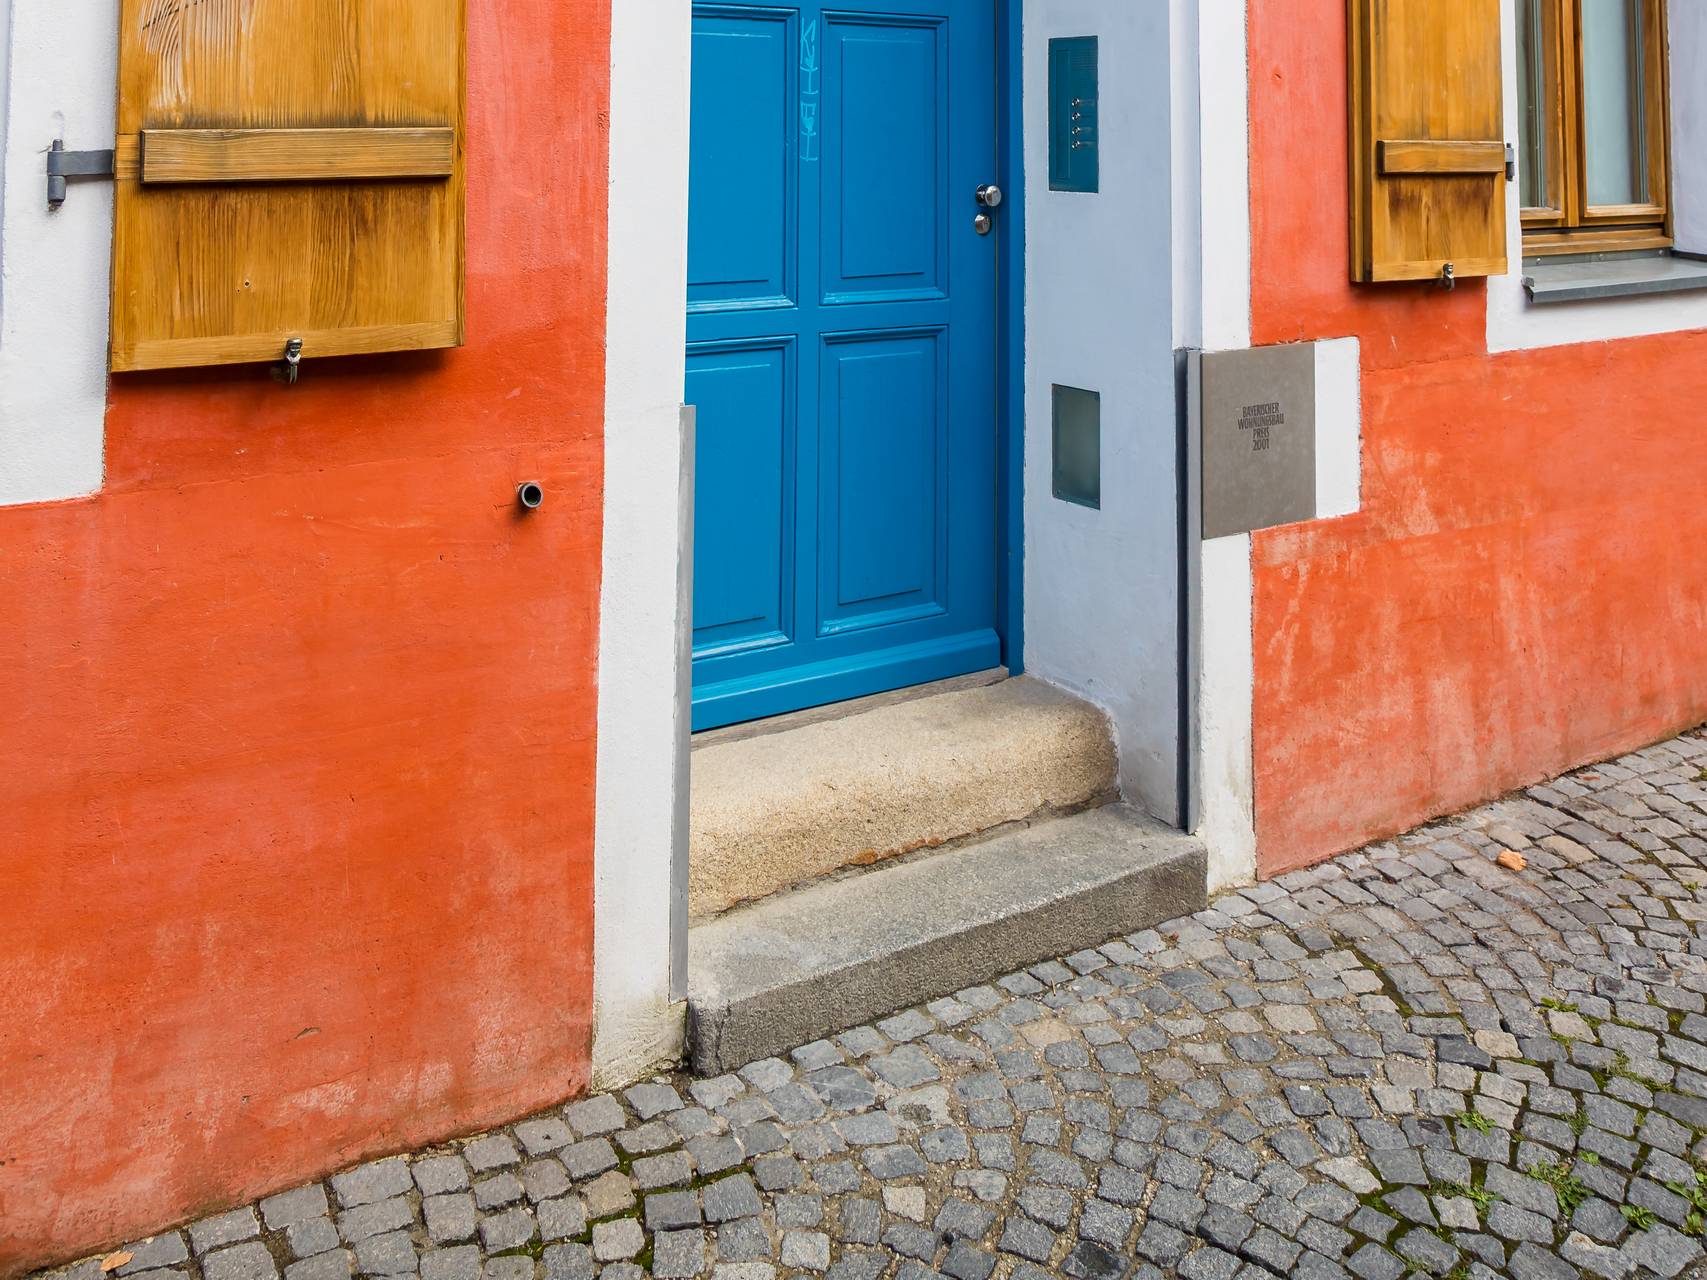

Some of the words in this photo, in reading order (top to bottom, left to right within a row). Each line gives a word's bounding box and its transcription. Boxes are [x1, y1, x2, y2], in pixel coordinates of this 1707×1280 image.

[1242, 402, 1280, 418] BAYERISCHER
[1237, 413, 1284, 430] WOHNUNGSBAU
[1252, 426, 1270, 439] PREIS
[1252, 438, 1270, 451] 2001
